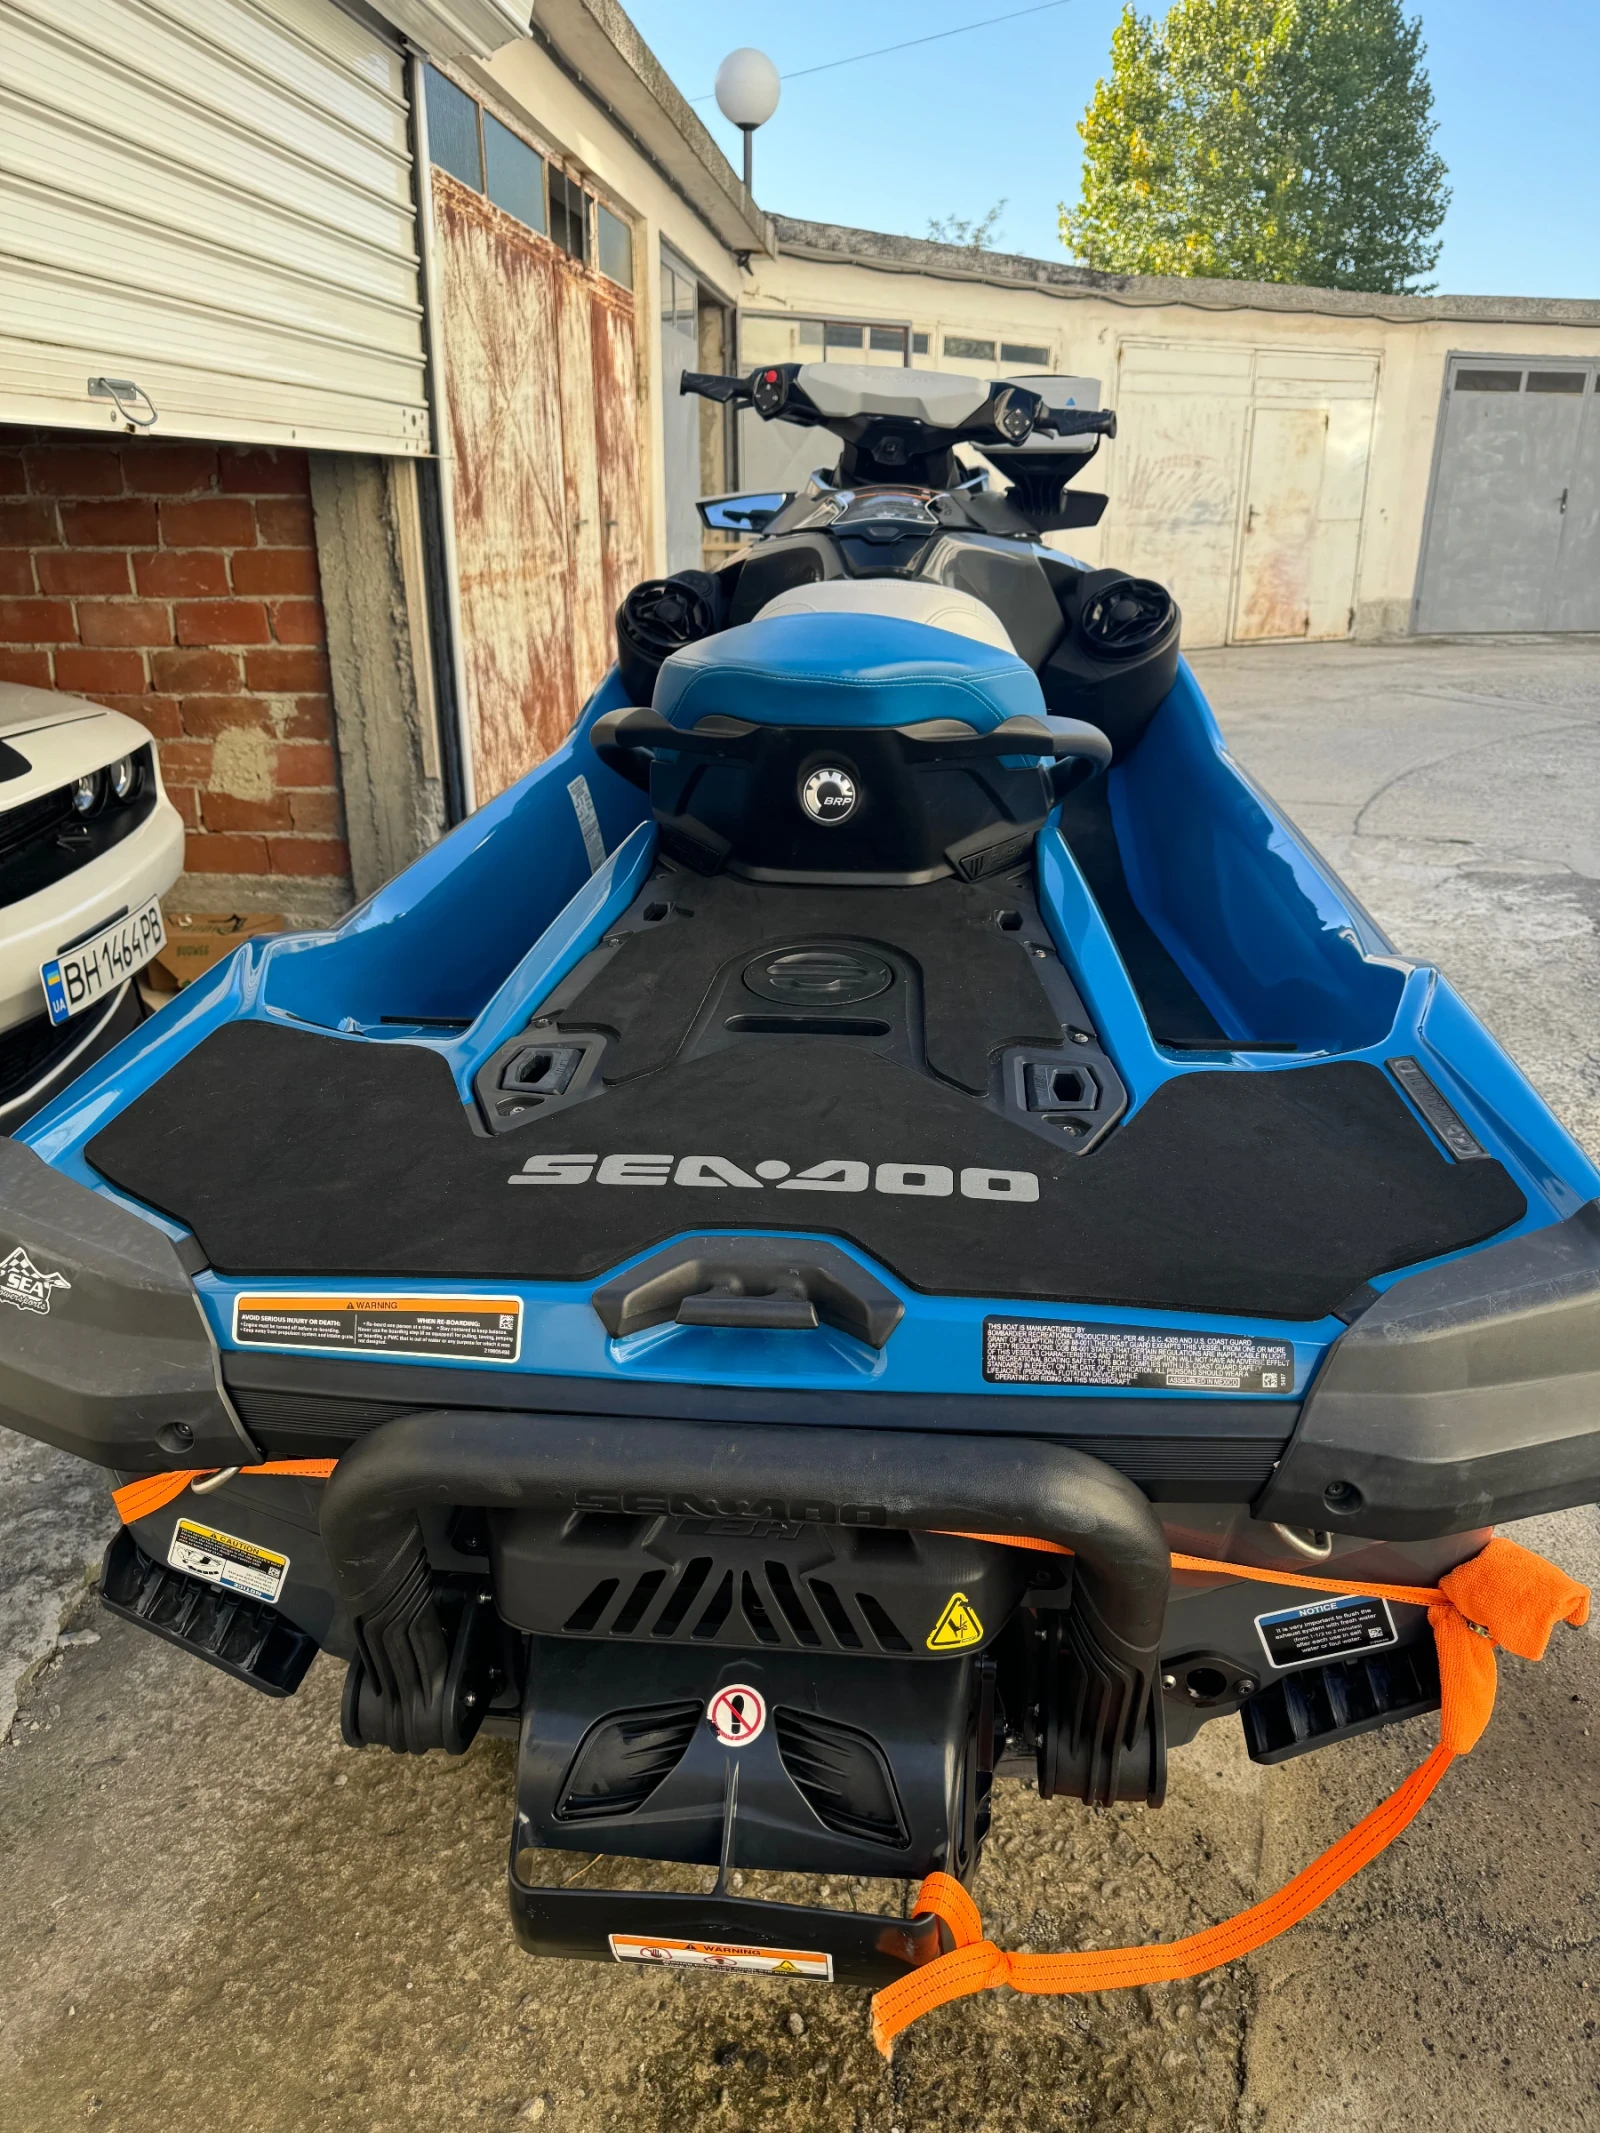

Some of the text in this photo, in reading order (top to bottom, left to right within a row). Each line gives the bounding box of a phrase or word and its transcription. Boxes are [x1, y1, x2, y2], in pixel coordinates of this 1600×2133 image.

[824, 796, 852, 806] BRP
[53, 999, 66, 1014] UA
[6, 1273, 44, 1298] SEA
[356, 1301, 398, 1310] WARNING
[1169, 1376, 1206, 1384] ASSEMBLED
[220, 1536, 260, 1555] CAUTION
[1299, 1602, 1338, 1616] NOTICE
[702, 1945, 761, 1956] WARNING
